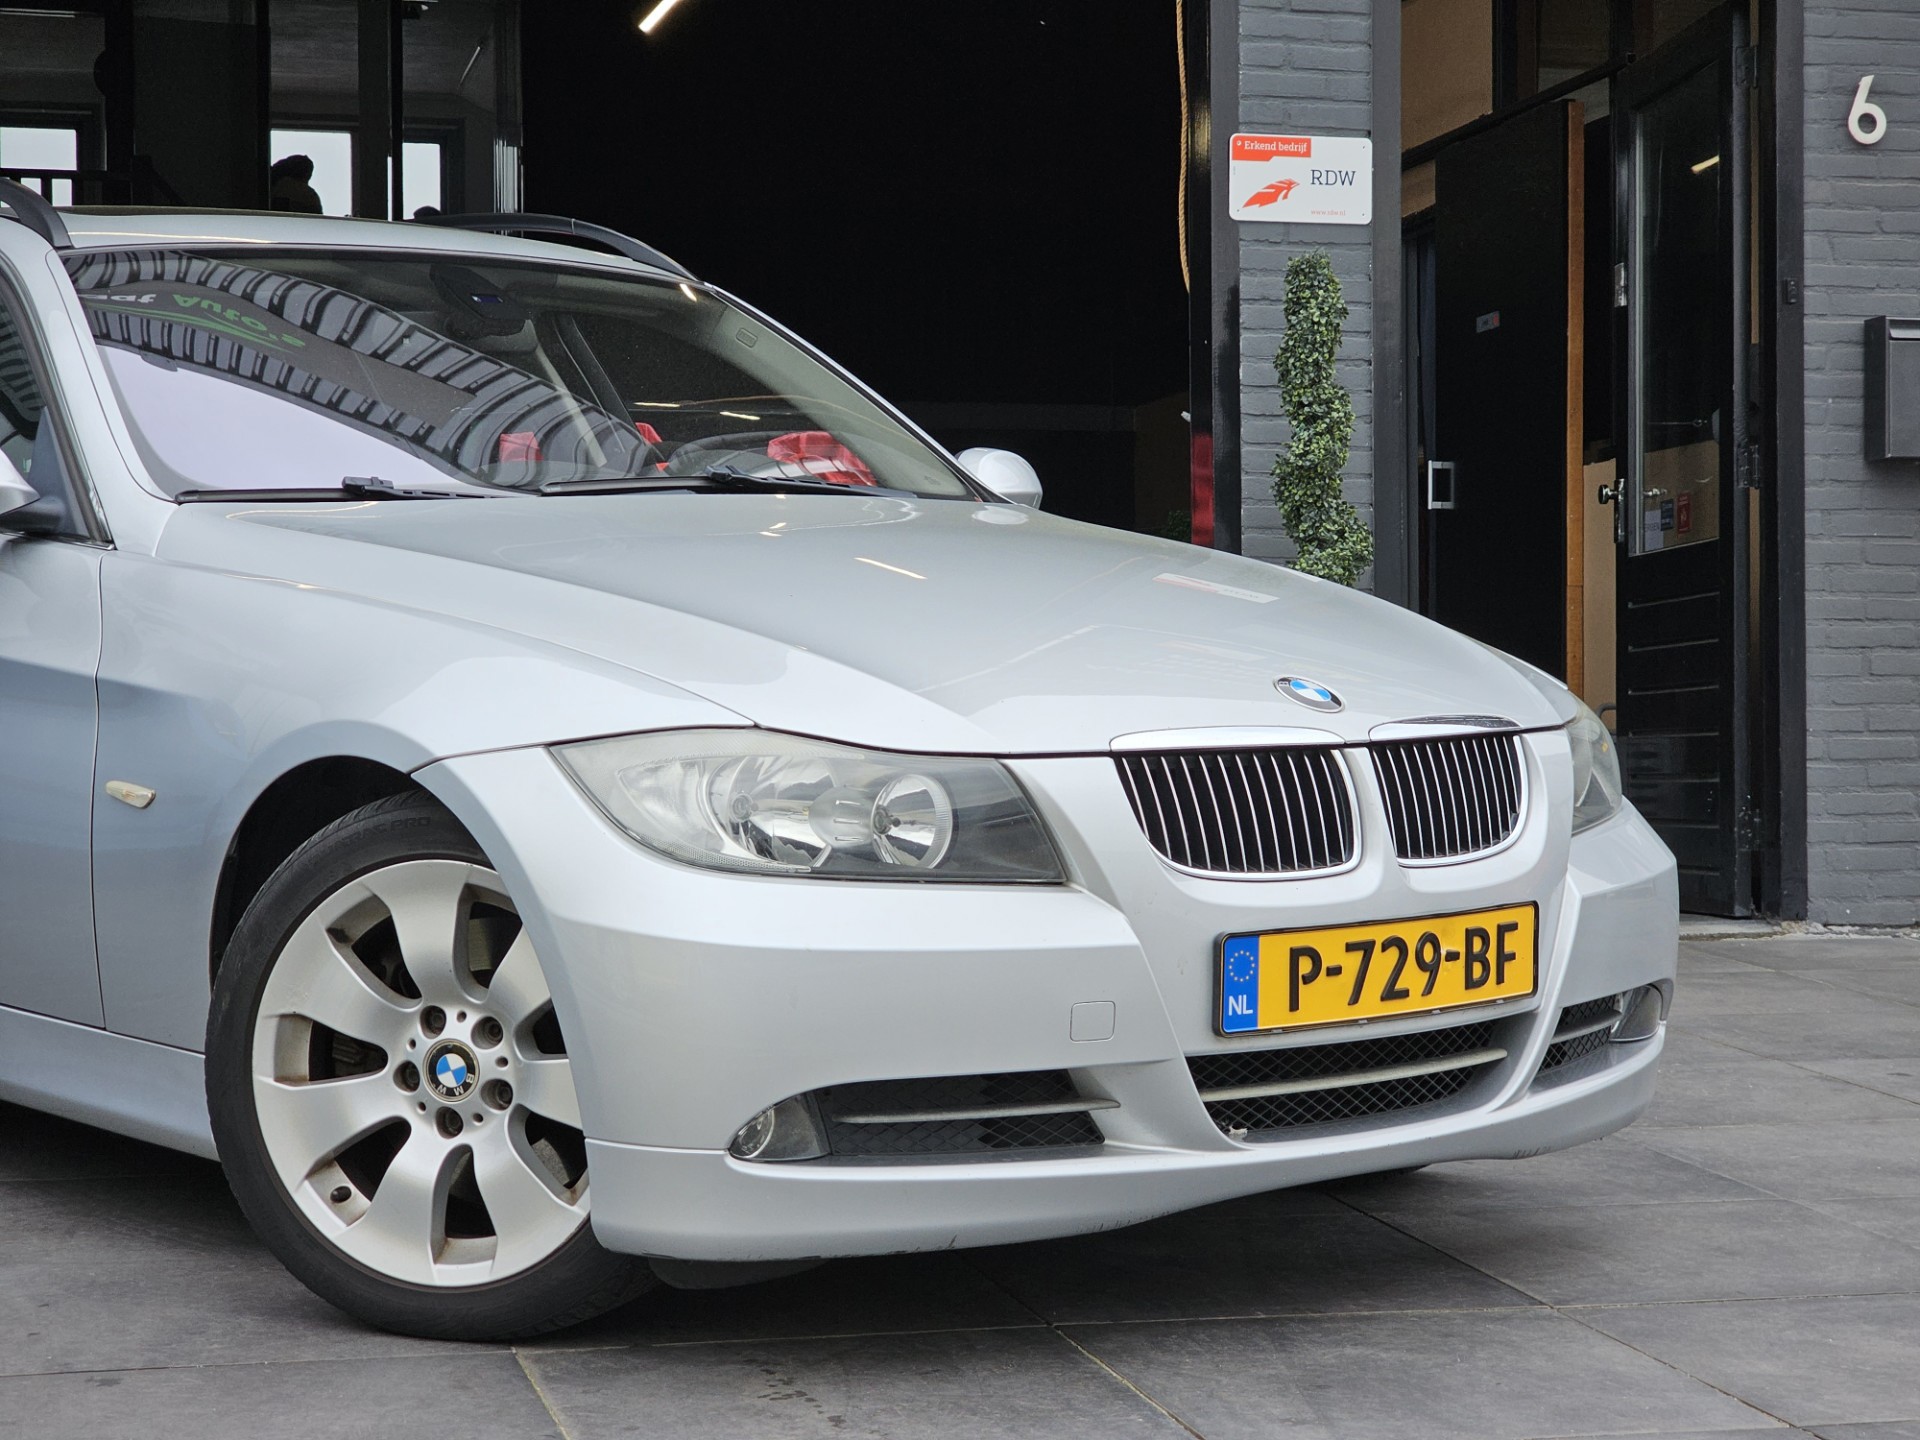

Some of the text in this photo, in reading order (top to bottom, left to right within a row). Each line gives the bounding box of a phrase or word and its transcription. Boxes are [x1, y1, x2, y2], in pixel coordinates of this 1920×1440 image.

[1848, 74, 1887, 145] 6
[1244, 140, 1307, 154] Erkend bedrijf
[1310, 169, 1356, 186] RDW
[390, 816, 432, 831] PRO
[1288, 920, 1519, 1013] P-729-BF
[1228, 994, 1253, 1016] NL
[437, 1072, 475, 1096] BMW
